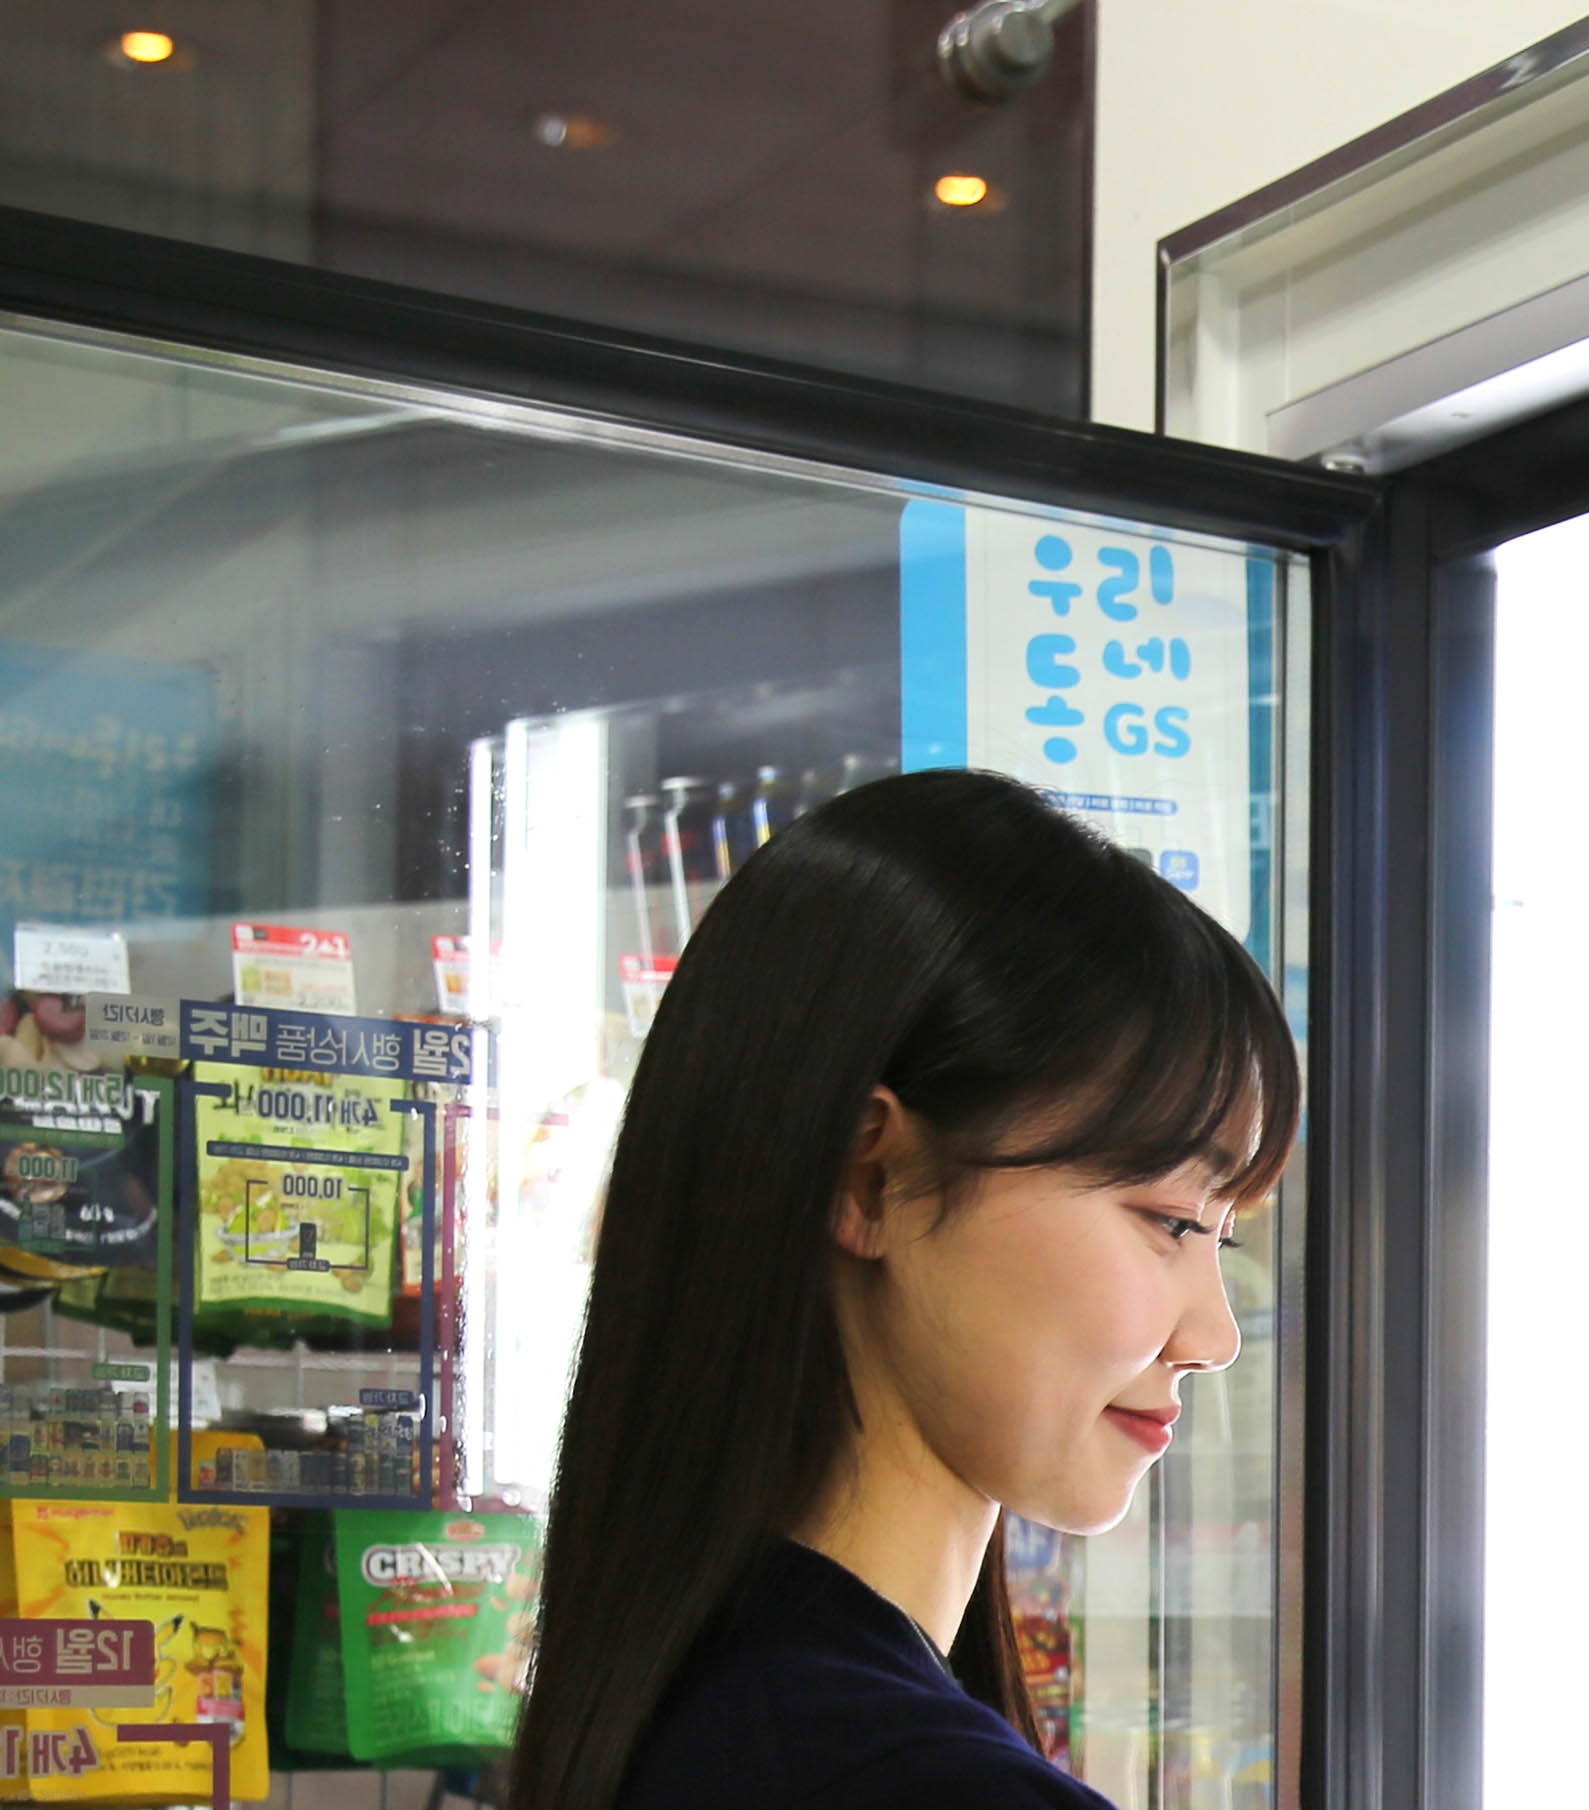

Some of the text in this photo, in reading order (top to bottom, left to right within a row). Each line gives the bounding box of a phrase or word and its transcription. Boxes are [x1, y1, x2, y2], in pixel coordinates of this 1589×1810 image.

[1028, 534, 1174, 622] 우리
[1025, 634, 1191, 764] 동네
[1104, 704, 1191, 759] GS
[367, 1545, 515, 1582] CRISPY
